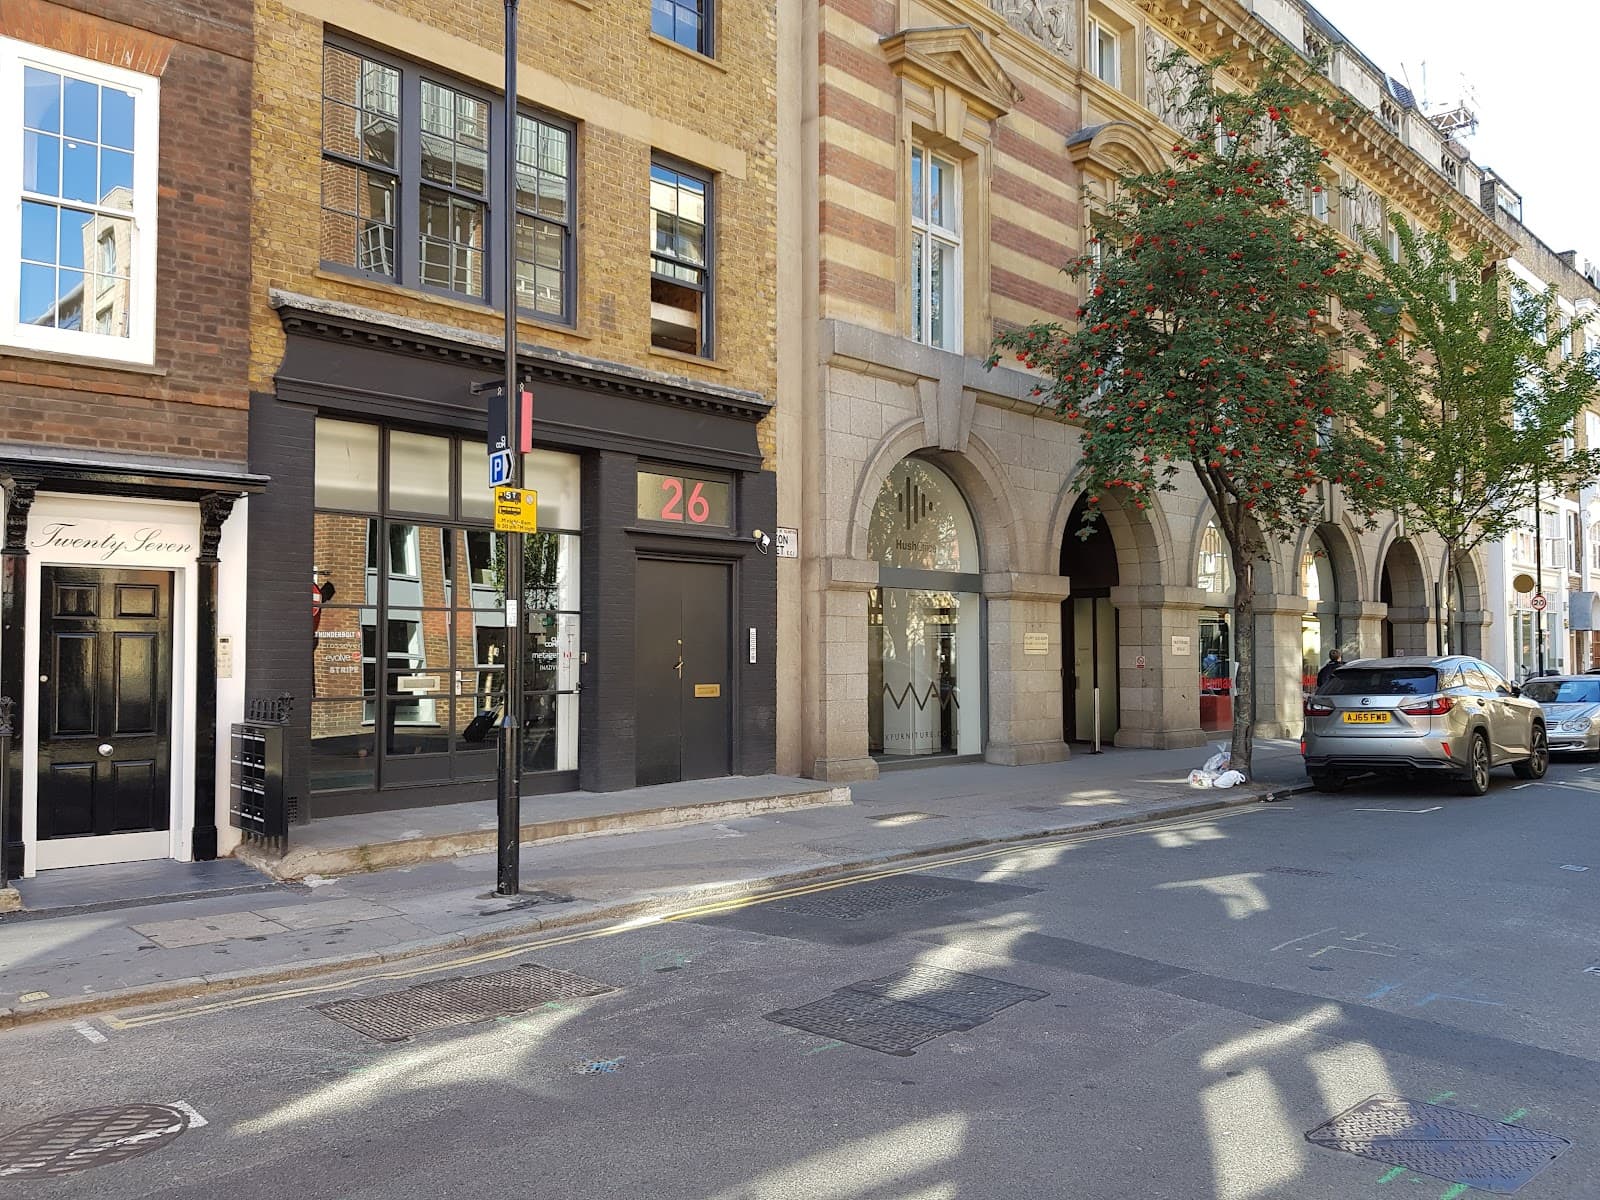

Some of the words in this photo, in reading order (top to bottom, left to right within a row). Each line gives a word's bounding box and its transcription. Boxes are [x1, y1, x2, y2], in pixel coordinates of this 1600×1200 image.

[494, 457, 502, 481] P
[661, 478, 710, 523] 26
[31, 522, 126, 561] Twenty
[126, 527, 193, 553] Seven
[1533, 599, 1545, 607] 20
[325, 653, 351, 662] evolve
[329, 666, 360, 674] STRIPE
[1347, 713, 1369, 721] AJ65
[1370, 713, 1388, 721] FWB
